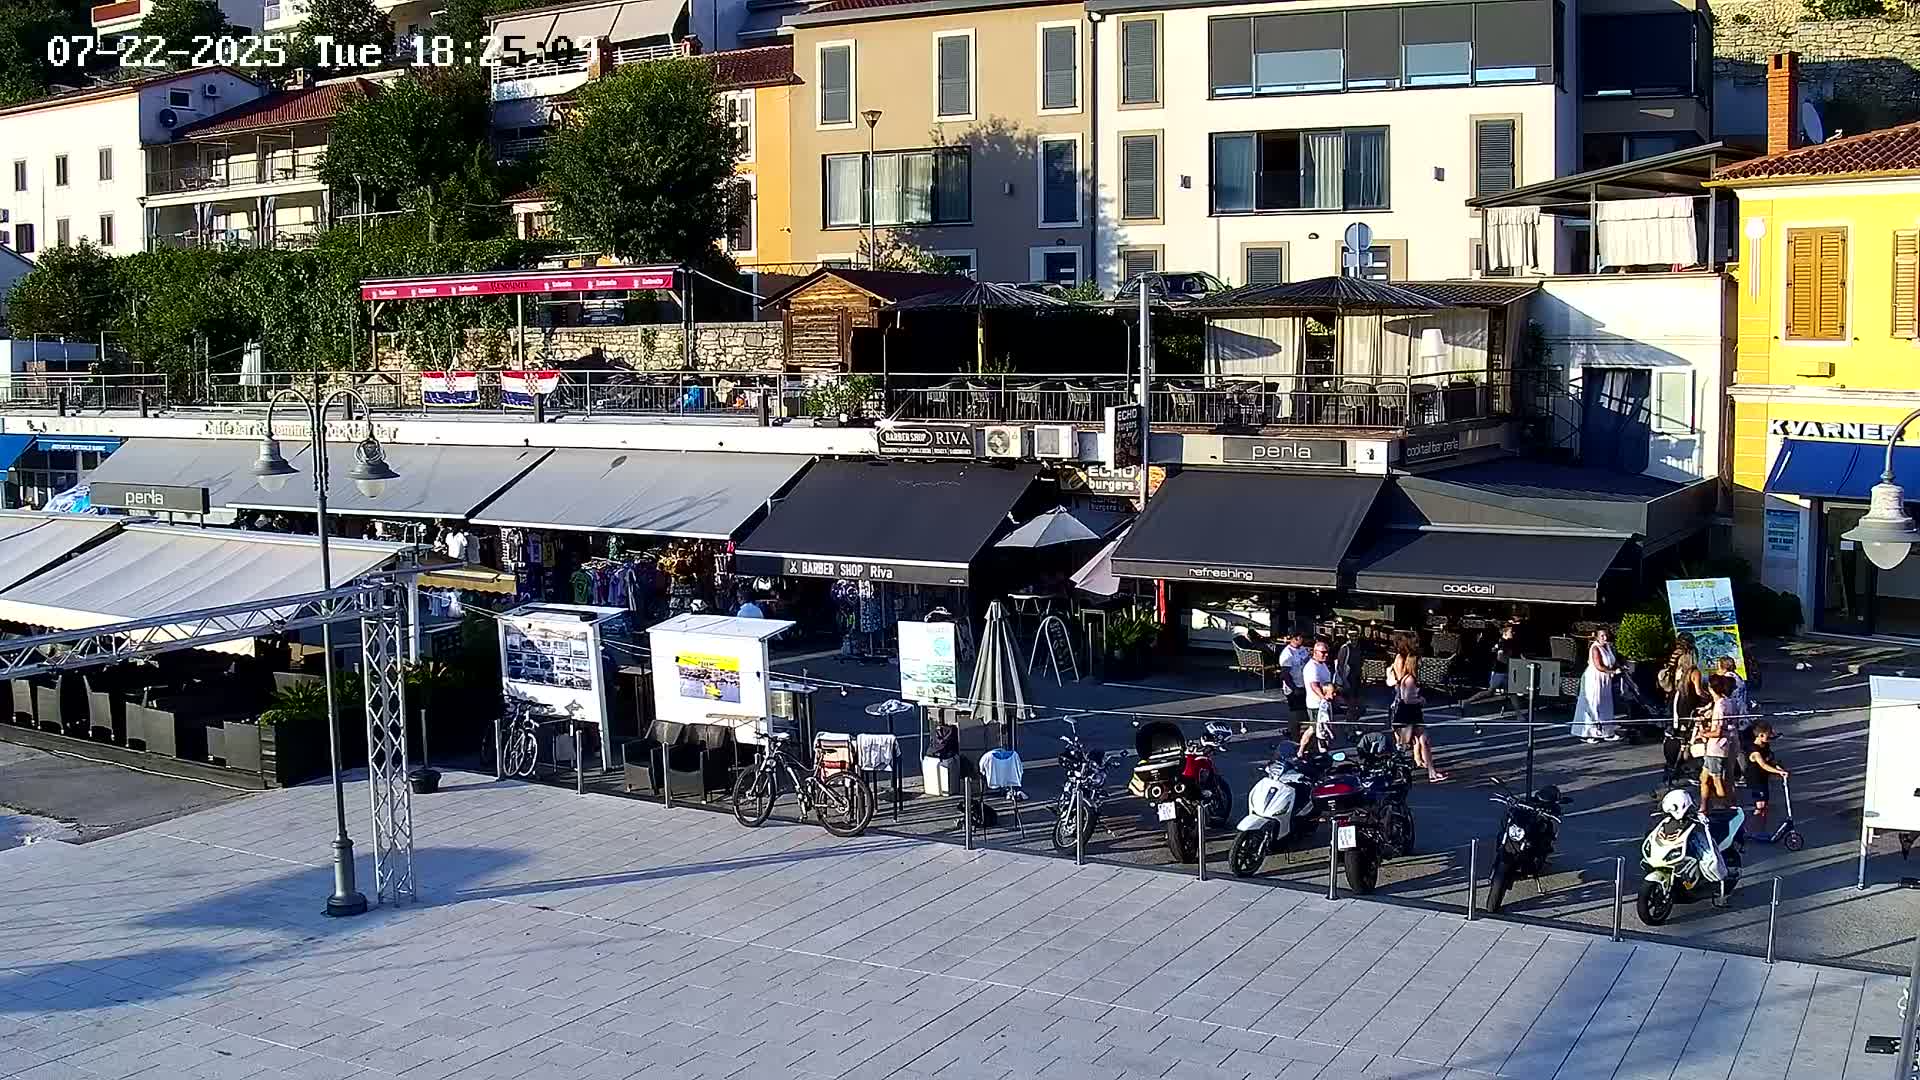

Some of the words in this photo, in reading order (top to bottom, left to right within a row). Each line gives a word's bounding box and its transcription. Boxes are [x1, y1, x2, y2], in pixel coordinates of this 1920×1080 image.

[1117, 409, 1138, 421] ECHO
[935, 431, 971, 445] RIVA
[1252, 443, 1312, 461] perla
[1088, 465, 1135, 478] ECHO
[1088, 478, 1135, 493] burgers
[125, 489, 164, 506] perla
[801, 561, 835, 576] BARBER
[840, 563, 864, 577] SHOP
[870, 565, 893, 579] Riva
[1188, 566, 1254, 581] refreshing
[1443, 582, 1496, 594] cocktail
